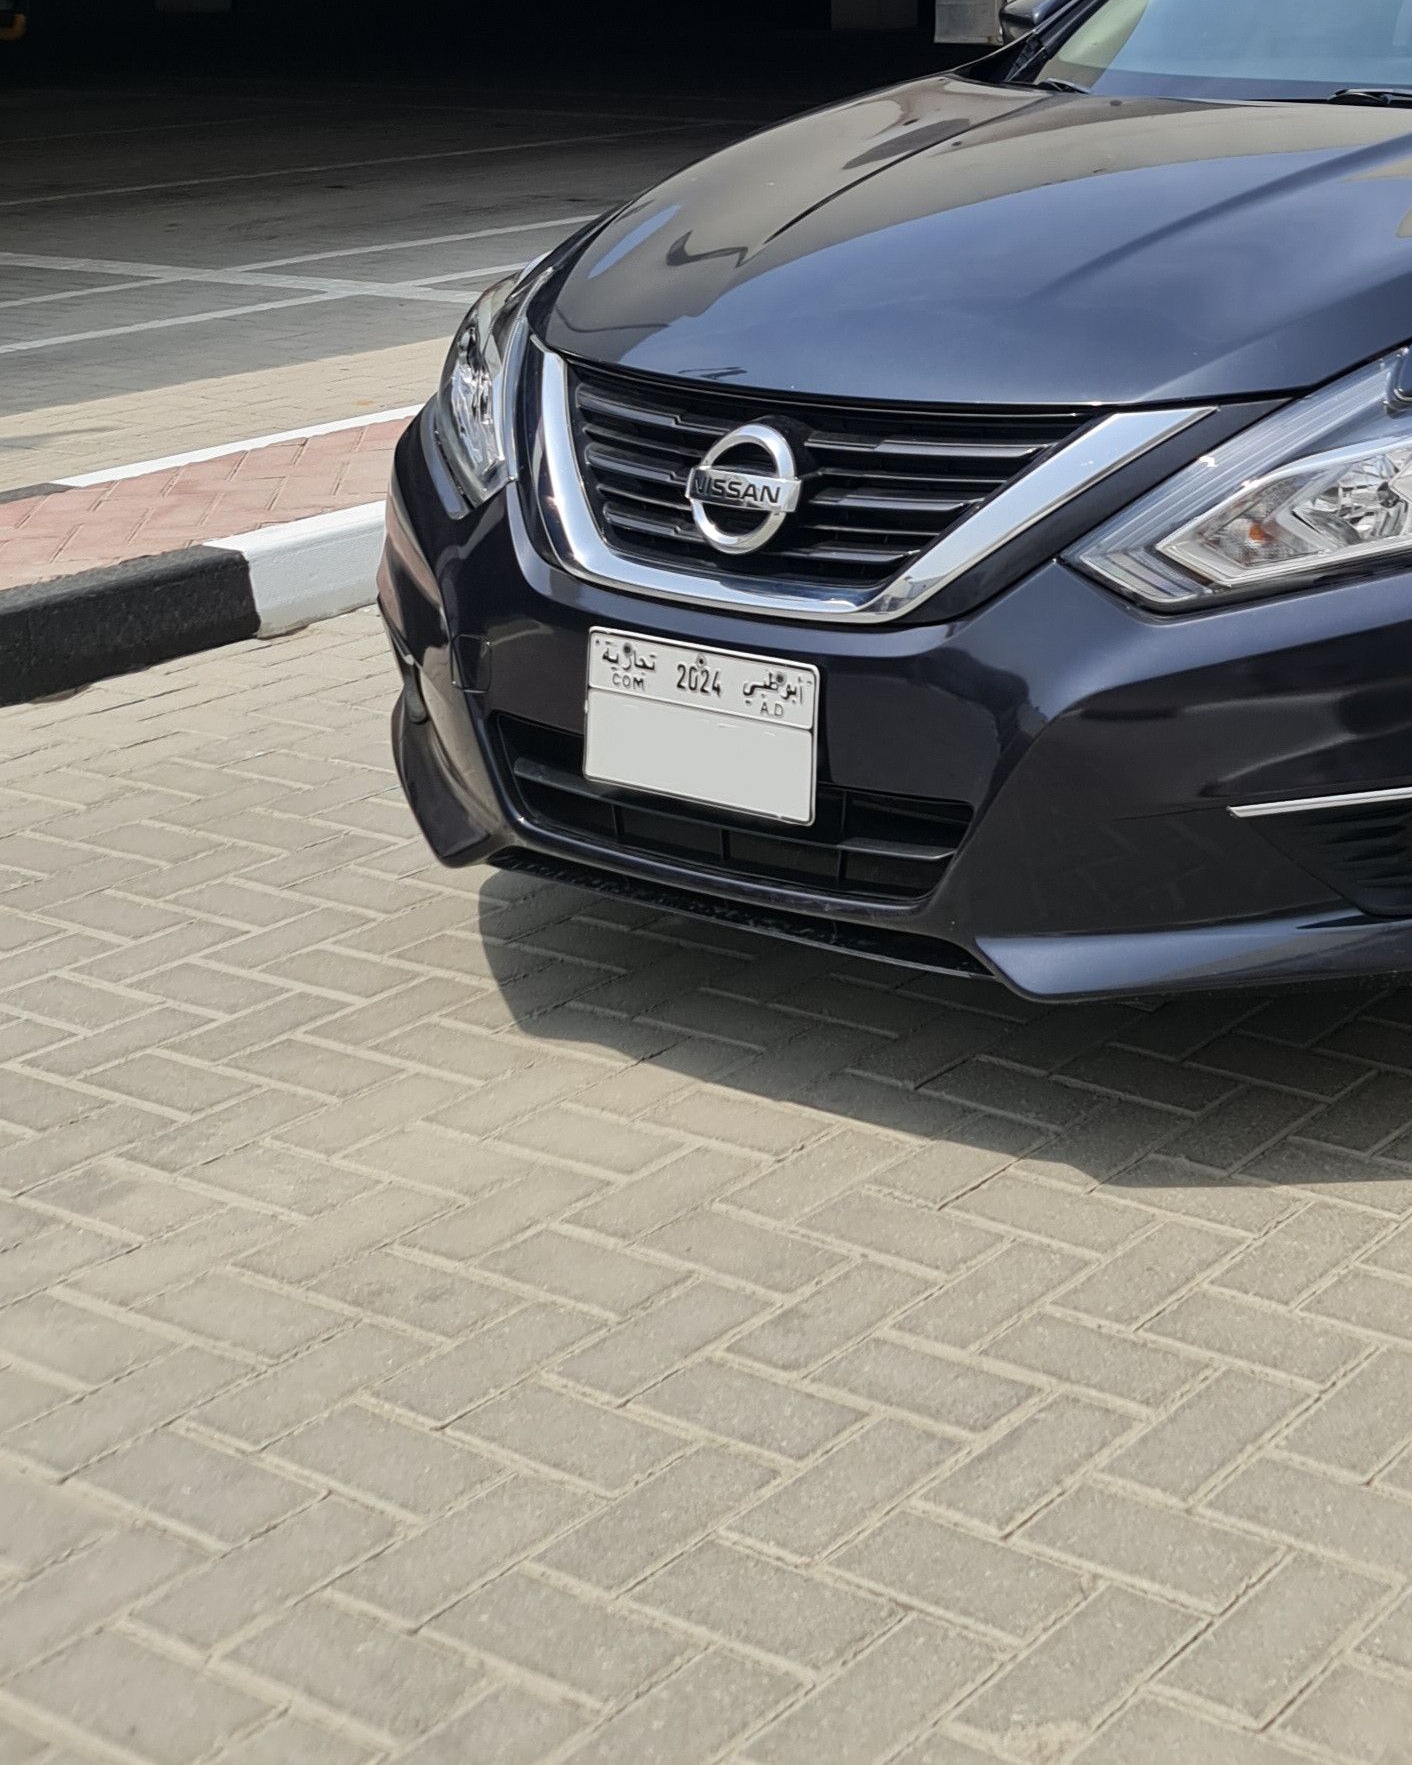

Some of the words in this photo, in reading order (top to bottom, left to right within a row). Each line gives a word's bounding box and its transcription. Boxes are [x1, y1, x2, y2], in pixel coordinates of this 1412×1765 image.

[693, 477, 781, 504] NISSAN
[602, 641, 656, 674] تجارية
[612, 672, 645, 692] COM
[676, 663, 721, 698] 2024
